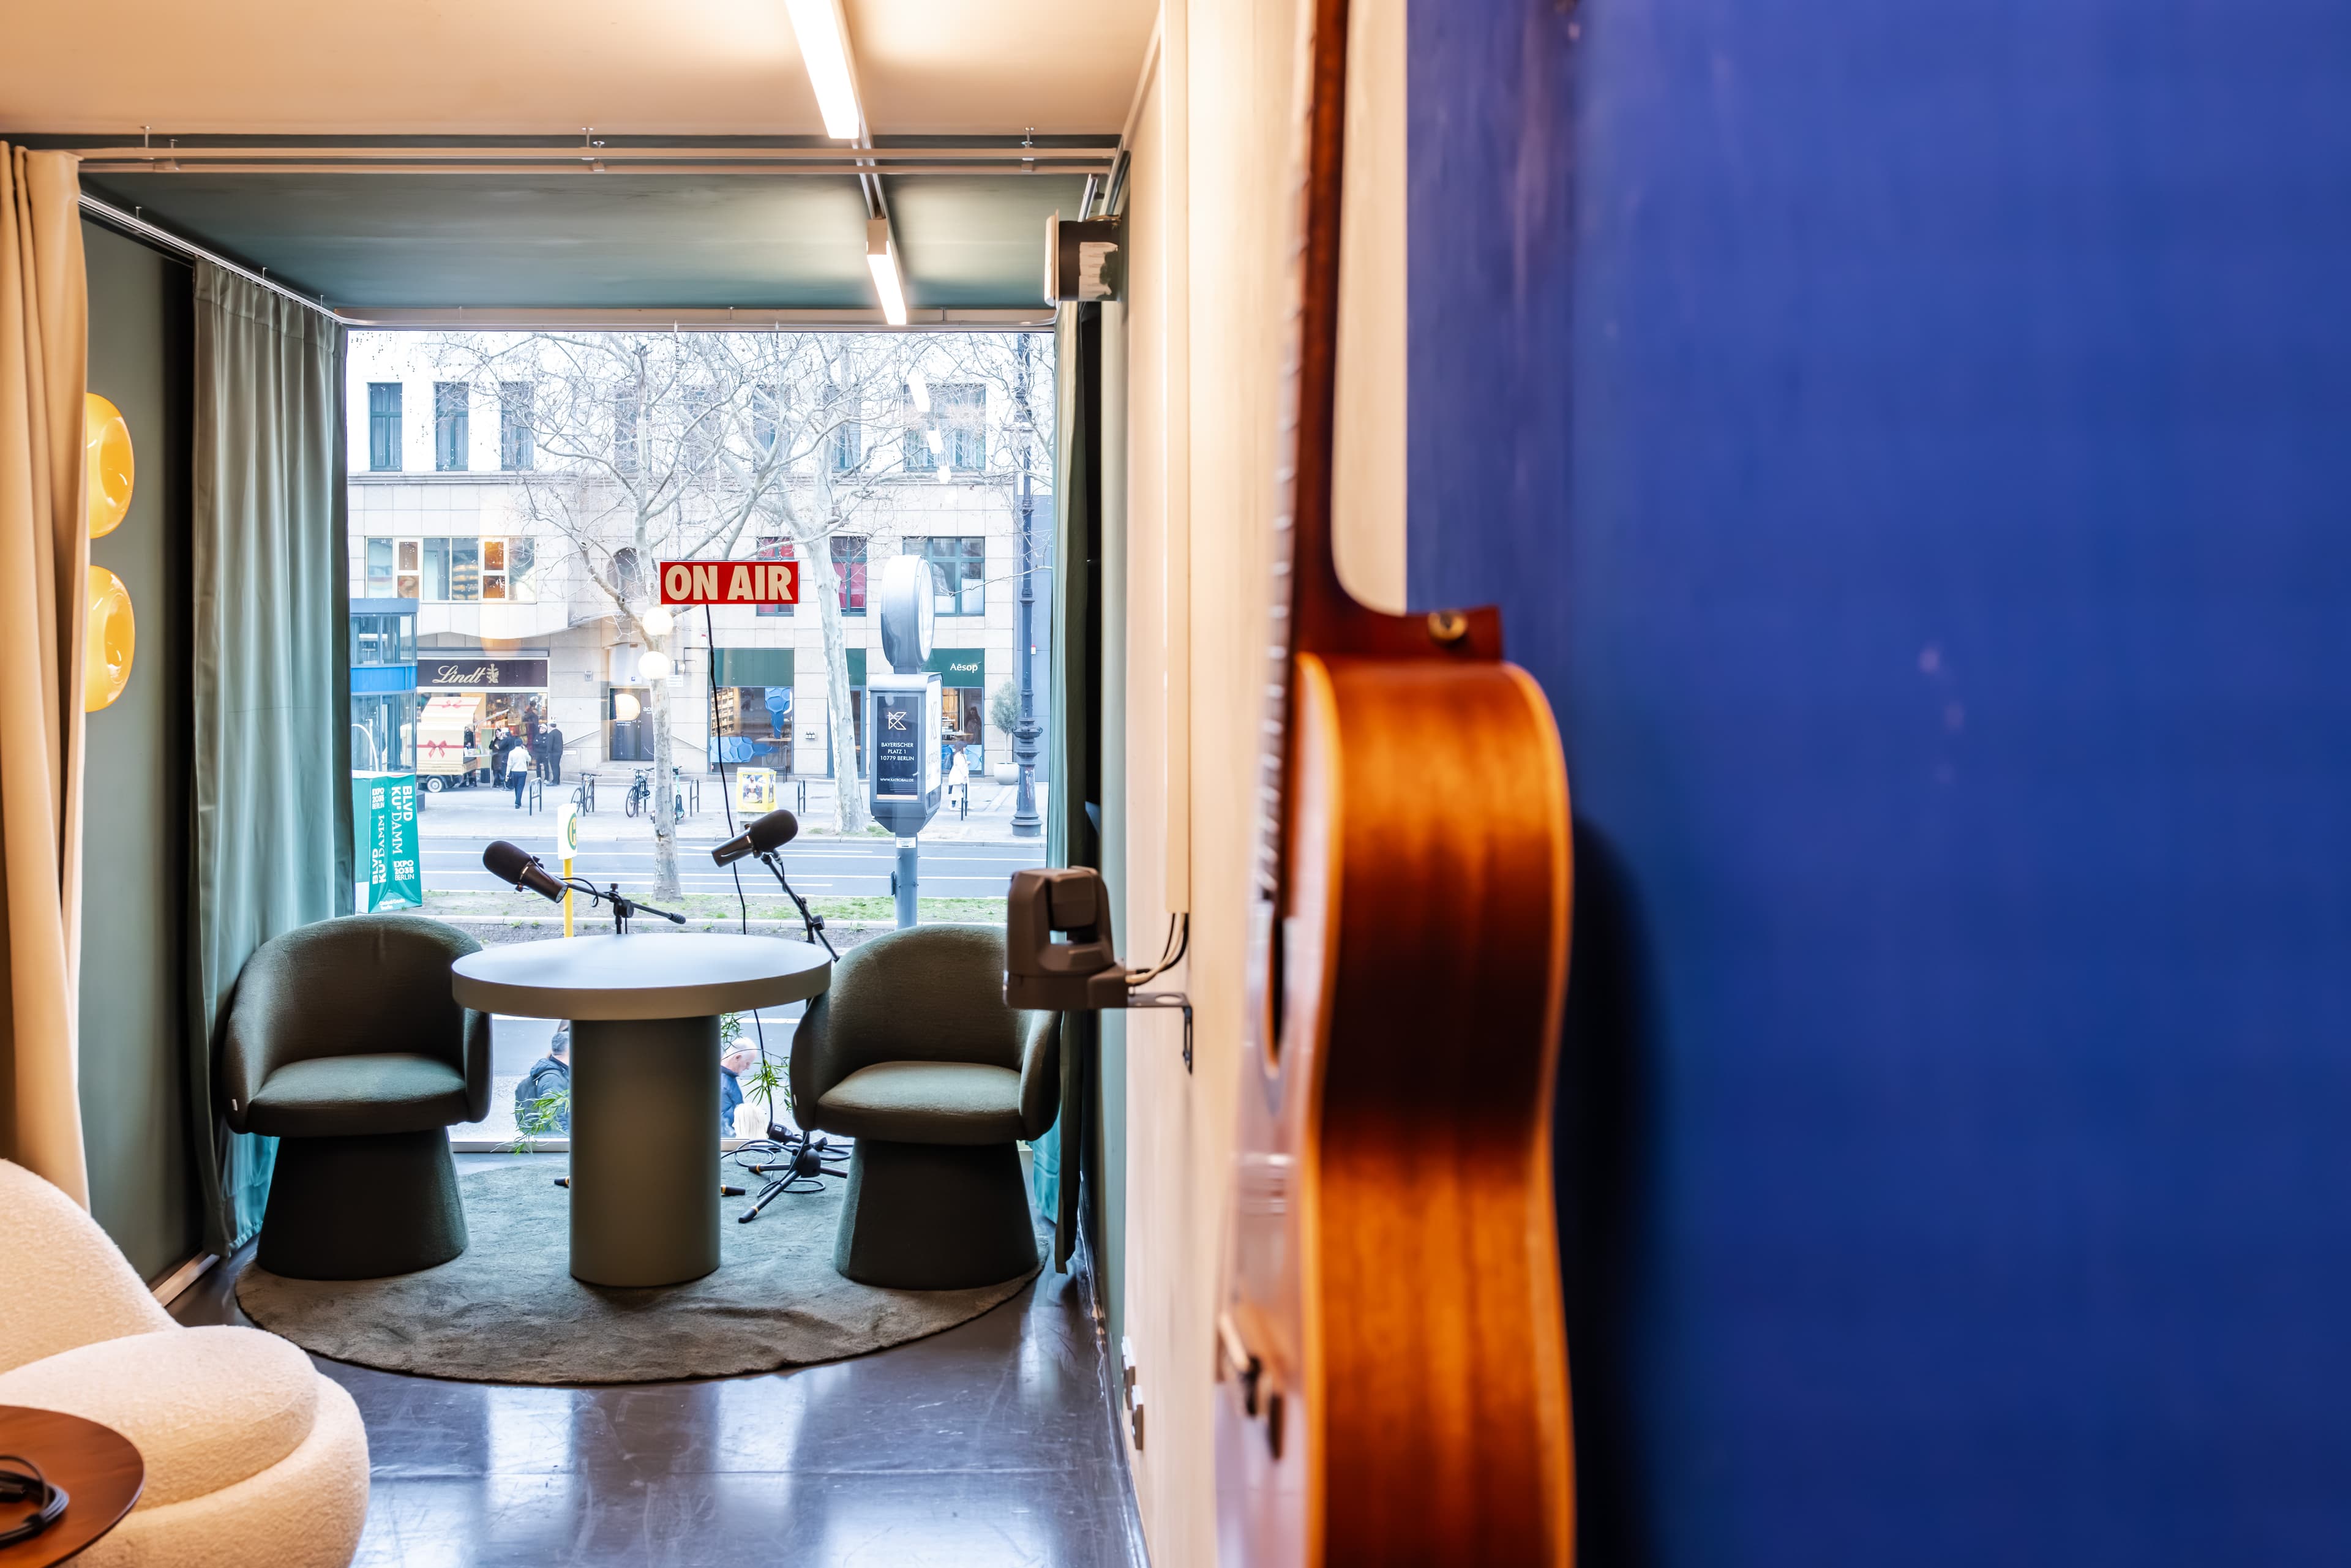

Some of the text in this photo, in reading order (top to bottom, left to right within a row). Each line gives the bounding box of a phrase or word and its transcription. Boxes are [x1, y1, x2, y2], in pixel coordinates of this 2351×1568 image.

[665, 565, 793, 601] ON AIR
[432, 665, 487, 684] Lindt
[950, 662, 978, 673] Aēsop
[402, 785, 413, 822] BLVD
[394, 872, 415, 881] BERLIN
